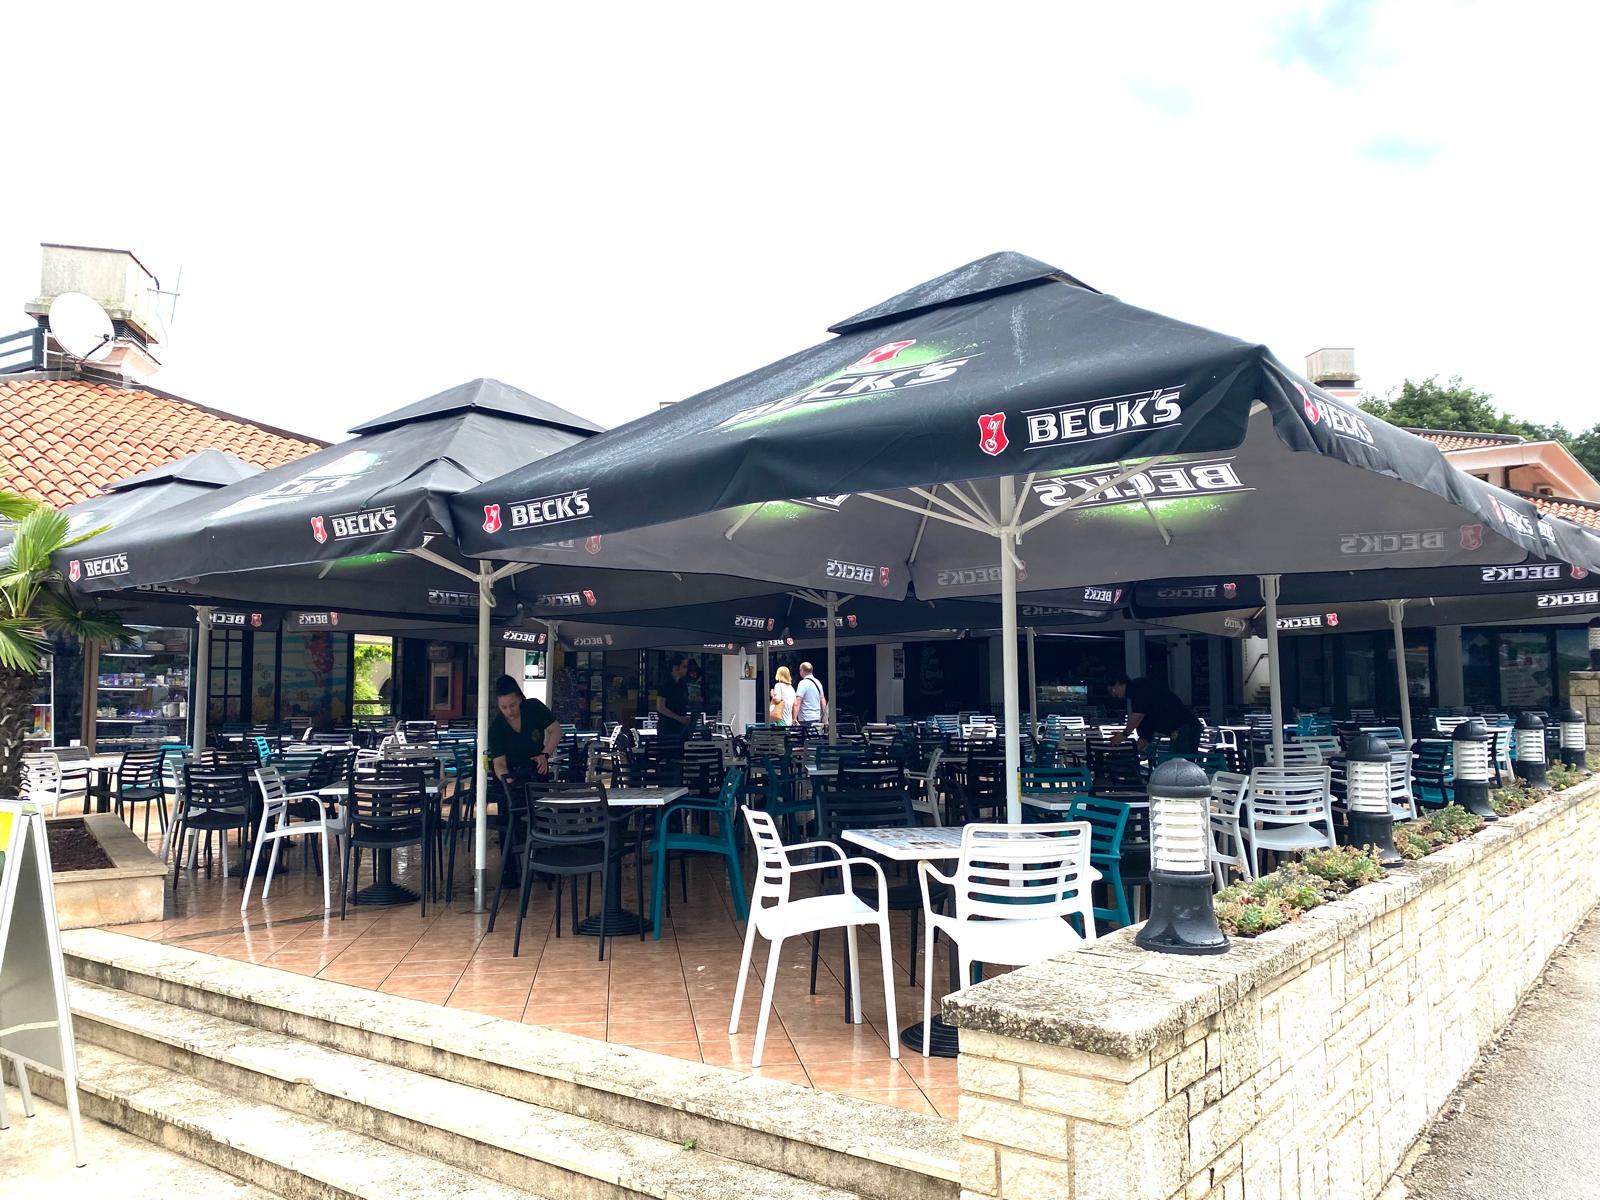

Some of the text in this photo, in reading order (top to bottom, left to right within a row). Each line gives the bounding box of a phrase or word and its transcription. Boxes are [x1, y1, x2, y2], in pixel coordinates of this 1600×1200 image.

[1026, 389, 1182, 444] BECK'S
[331, 507, 397, 537] BECK'S
[510, 490, 590, 527] BECK'S
[84, 553, 129, 577] BECK'S
